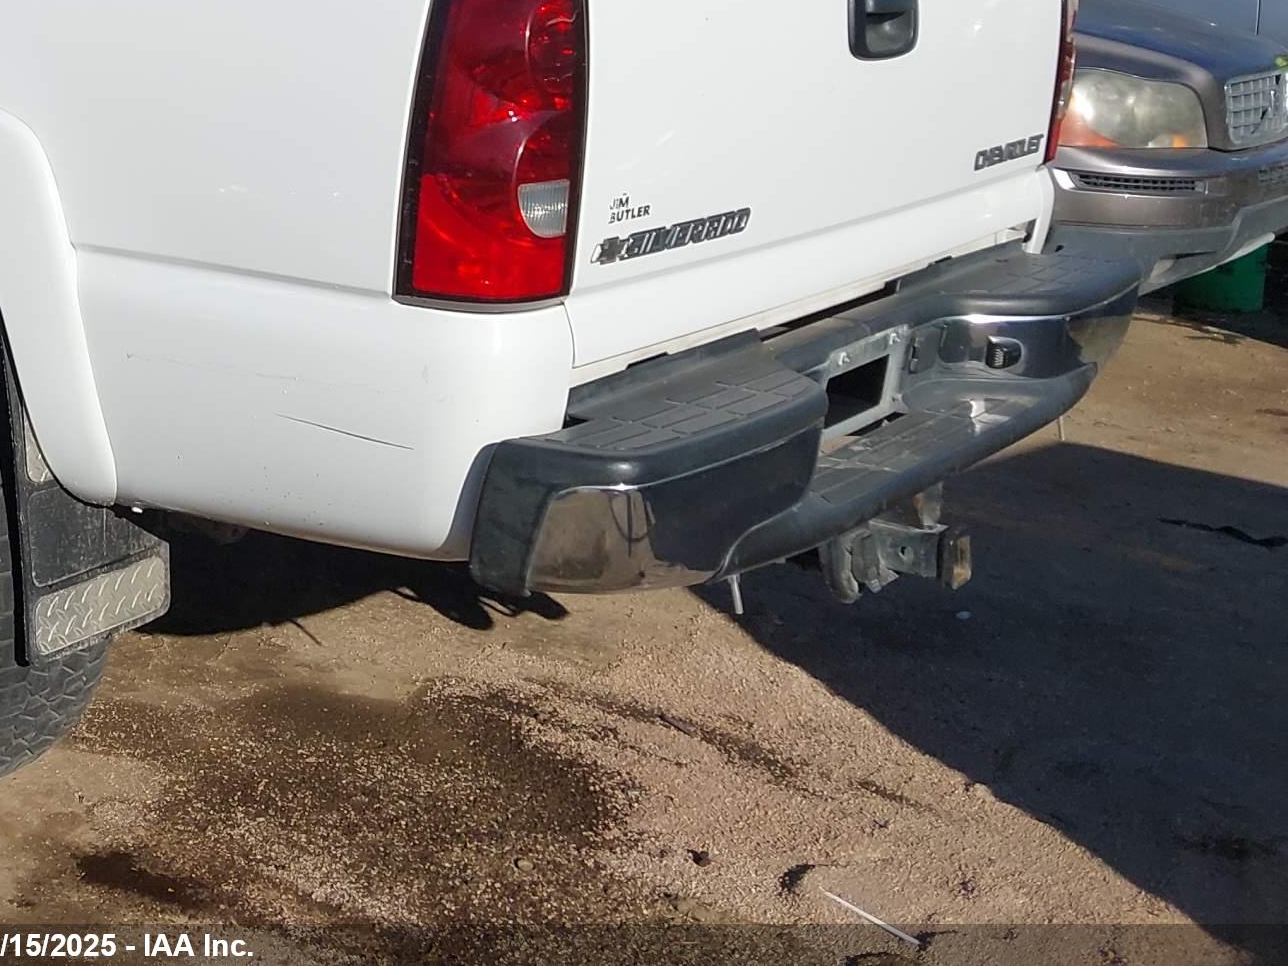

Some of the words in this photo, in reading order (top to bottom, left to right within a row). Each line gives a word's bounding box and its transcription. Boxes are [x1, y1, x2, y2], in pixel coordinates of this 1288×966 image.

[609, 196, 630, 210] JIM
[608, 204, 651, 224] BUTLER
[619, 207, 751, 261] SILVERADO
